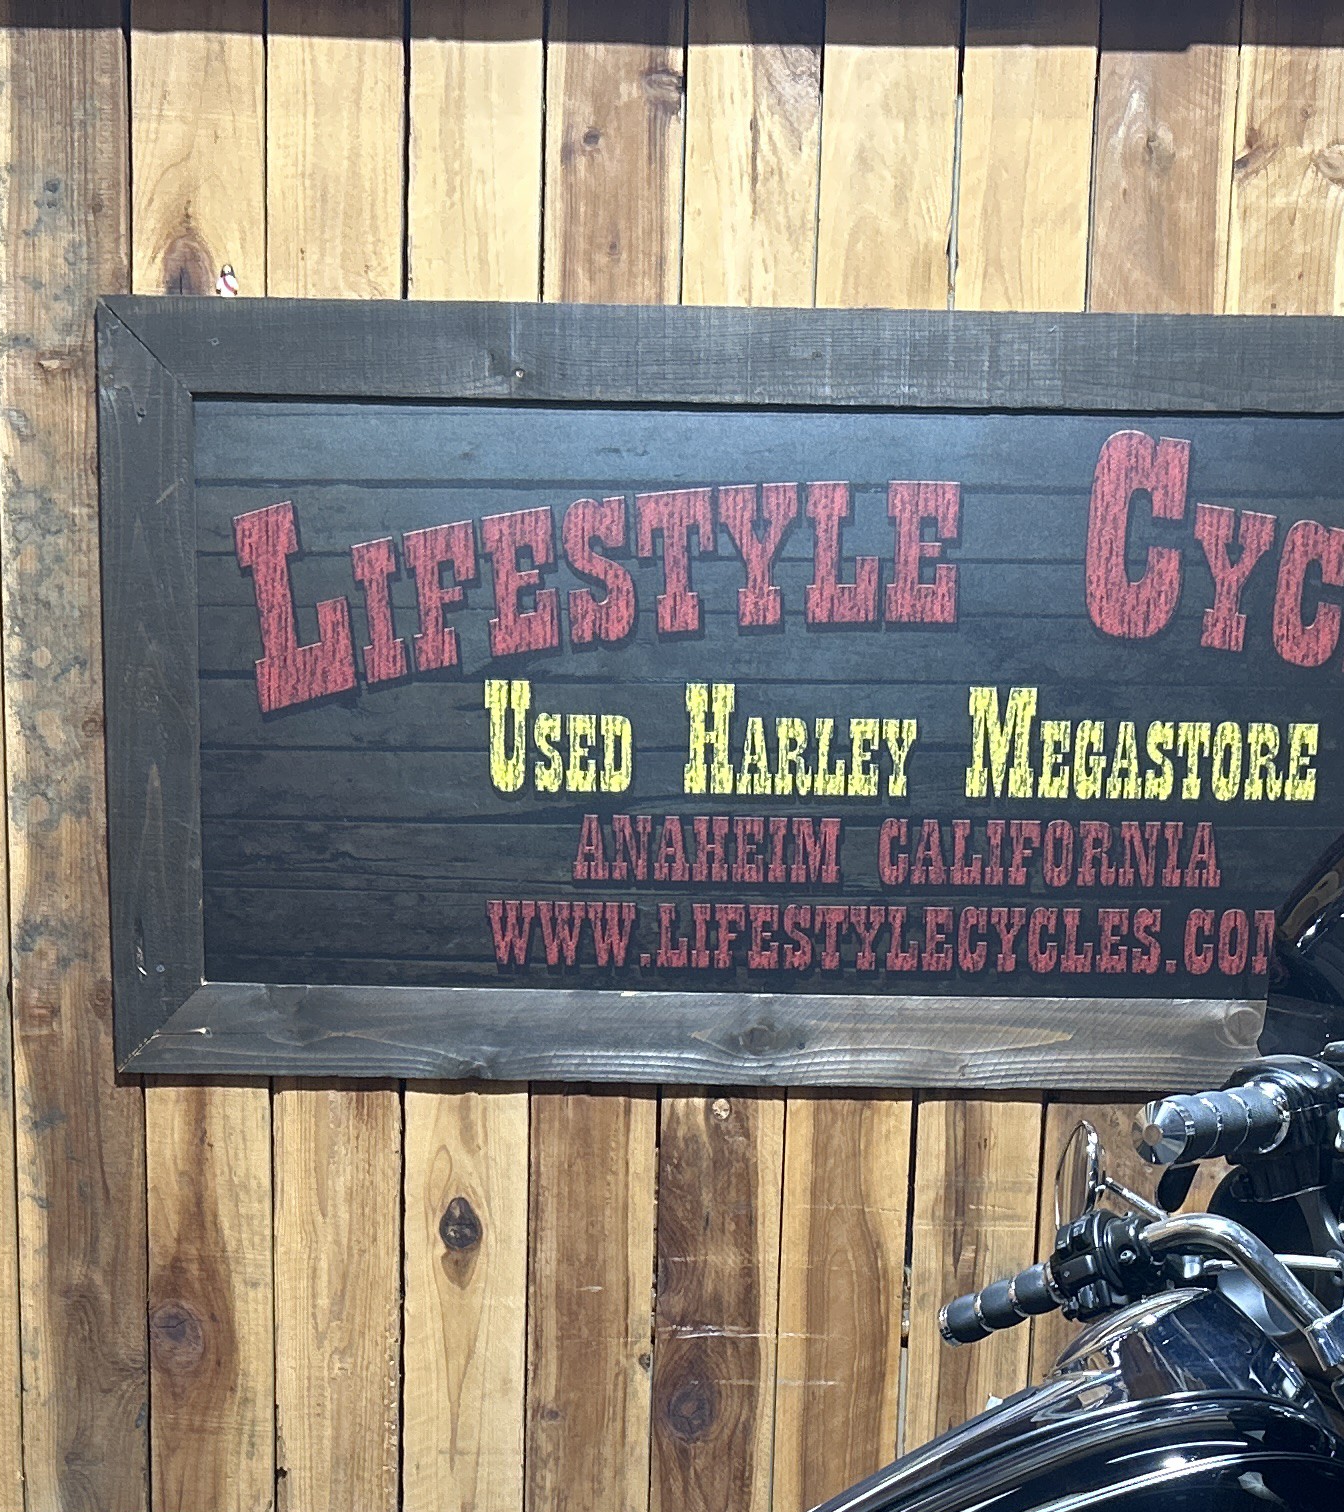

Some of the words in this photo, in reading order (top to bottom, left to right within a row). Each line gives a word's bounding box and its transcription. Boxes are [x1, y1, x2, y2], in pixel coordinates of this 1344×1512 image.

[233, 479, 960, 711] LIFESTYLE
[484, 680, 633, 793] USED
[683, 683, 917, 798] HARLEY
[965, 687, 1319, 801] MEGASTORE
[573, 815, 840, 885] ANAHEIM
[877, 819, 1222, 888] CALIFORNIA
